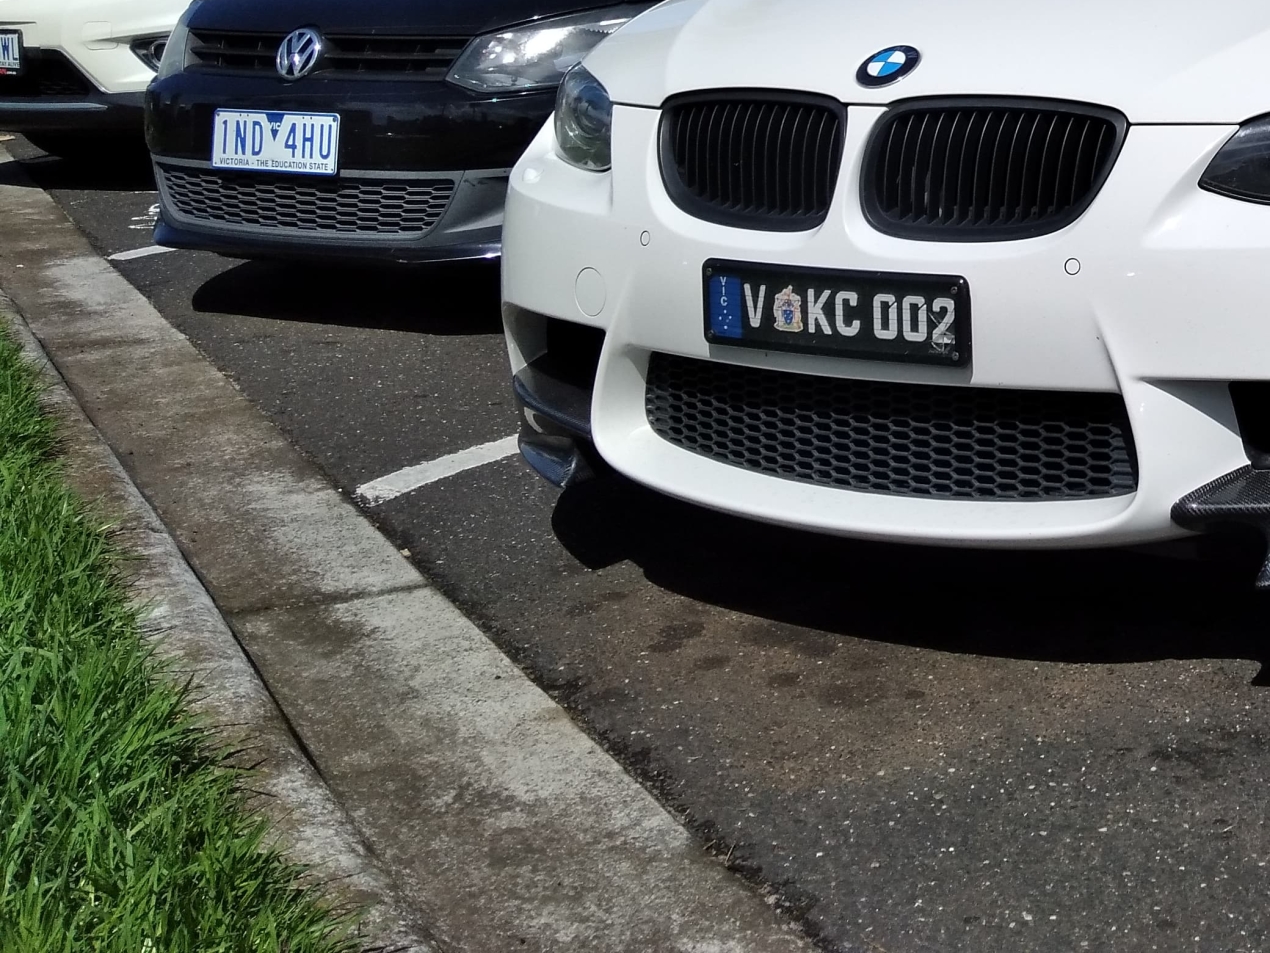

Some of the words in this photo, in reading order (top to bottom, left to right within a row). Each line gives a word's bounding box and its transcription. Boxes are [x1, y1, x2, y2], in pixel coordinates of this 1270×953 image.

[222, 119, 264, 156] 1ND
[284, 122, 333, 160] 4HU
[219, 157, 249, 166] VICTORIA
[256, 159, 269, 167] THE
[271, 160, 307, 169] EDUCATION
[309, 162, 328, 170] STATE
[807, 288, 861, 337] KC
[872, 293, 956, 346] 002
